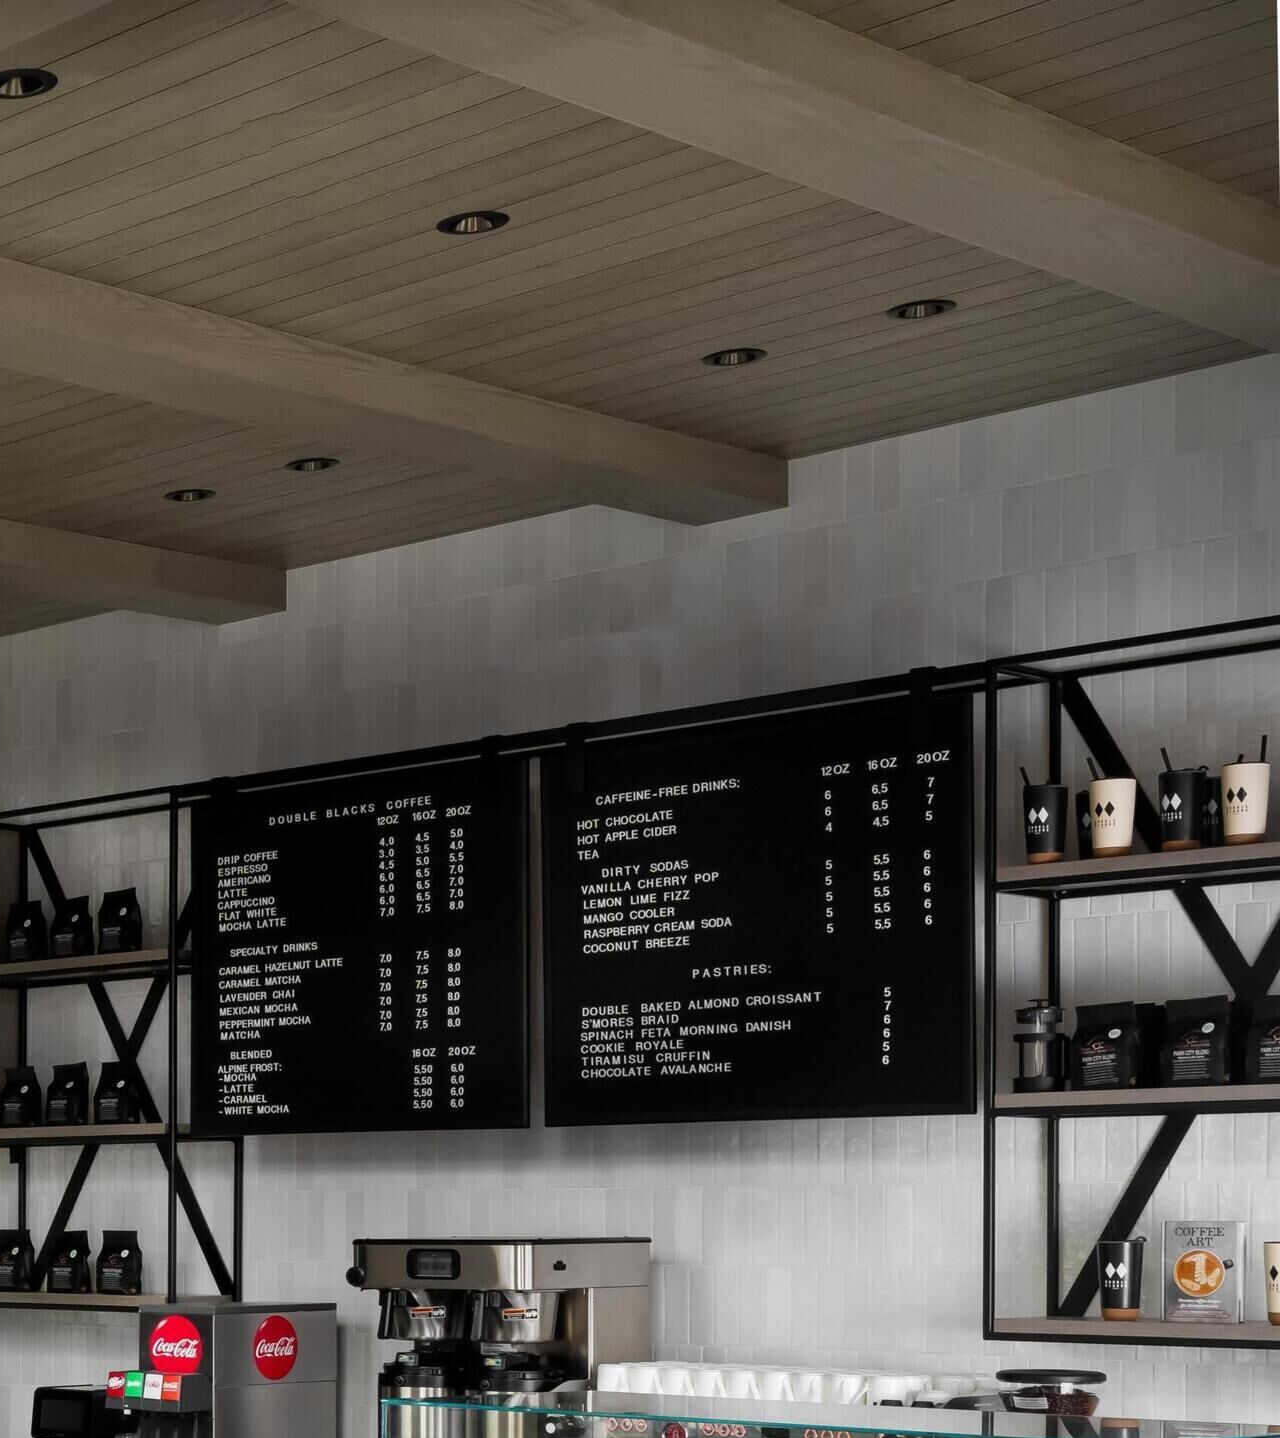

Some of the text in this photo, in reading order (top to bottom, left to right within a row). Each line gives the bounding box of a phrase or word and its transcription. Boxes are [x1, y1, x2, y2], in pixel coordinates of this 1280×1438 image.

[596, 785, 688, 805] CAFFEINE-FREE
[825, 777, 934, 800] 6 6.5 7
[269, 796, 431, 826] DOUBLE BLACKS COFFEE
[825, 794, 934, 816] 6 6.5 7
[577, 810, 672, 830] HOT CHOCOLATE
[826, 810, 932, 832] 4 4.5 5
[379, 828, 463, 846] 4.0 4.5 5.0
[578, 825, 676, 846] HOT APPLE CIDER
[379, 840, 464, 858] 3.0 3.5 4.0
[577, 850, 599, 860] TEA
[218, 850, 278, 865] DRIP COFFEE
[379, 852, 464, 870] 4.5 5.0 5.5
[826, 850, 931, 870] 5 5.5 6
[218, 863, 268, 877] ESPRESSO
[380, 864, 464, 881] 6.0 6.5 7.0
[602, 860, 688, 878] DIRTY SODAS
[825, 866, 930, 886] 5 5.5 6
[218, 874, 271, 888] AMERICANO
[380, 876, 464, 893] 6.0 6.5 7.0
[581, 872, 719, 895] VANILLA CHERRY POP
[218, 888, 247, 899] LATTE
[380, 888, 463, 905] 6.0 6.5 7.0
[584, 890, 690, 909] LEMON LIME FIZZ
[826, 882, 931, 902] 5 5.5 6
[218, 896, 275, 910] CAPPUCCINO
[380, 900, 464, 916] 7.0 7.5 8.0
[826, 899, 931, 917] 5 5.5 6
[219, 907, 276, 921] FLAT WHITE
[584, 907, 674, 924] MANGO COOLER
[219, 918, 286, 932] MOCHA LATTE
[584, 917, 732, 939] RASPBERRY CREAM SODA
[826, 915, 932, 933] 5 5.5 6
[230, 942, 318, 957] SPECIALTY DRINKS
[583, 936, 690, 954] COCONUT BREEZE
[219, 958, 343, 976] CARAMEL HAZELNUT LATTE
[219, 975, 301, 990] CARAMEL MATCHA
[220, 989, 294, 1003] LAVENDER CHAI
[884, 987, 891, 997] 5
[220, 1003, 298, 1016] MEXICAN MOCHA
[582, 992, 821, 1016] DOUBLE BAKED ALMOND CROISSANT
[884, 1000, 891, 1011] 7
[220, 1016, 311, 1029] PEPPERMINT MOCHA
[641, 1014, 679, 1025] BRAID
[884, 1014, 891, 1024] 6
[220, 1030, 260, 1040] MATCHA
[581, 1020, 791, 1041] SPINACH FETA MORNING DANISH
[883, 1028, 890, 1038] 6
[581, 1040, 684, 1054] COOKIE ROYALE
[882, 1041, 890, 1052] 5
[230, 1050, 272, 1060] BLENDED
[582, 1051, 710, 1066] TIRAMISU CRUFFIN
[882, 1055, 889, 1065] 6
[218, 1064, 248, 1074] ALPINE
[581, 1062, 731, 1078] CHOCOLATE AVALANCHE
[257, 1105, 289, 1114] MOCHA
[1175, 1227, 1225, 1237] COFFEE
[1186, 1237, 1213, 1247] ART
[153, 1337, 200, 1358] Coca-Cola
[256, 1337, 296, 1358] Coca-Cola
